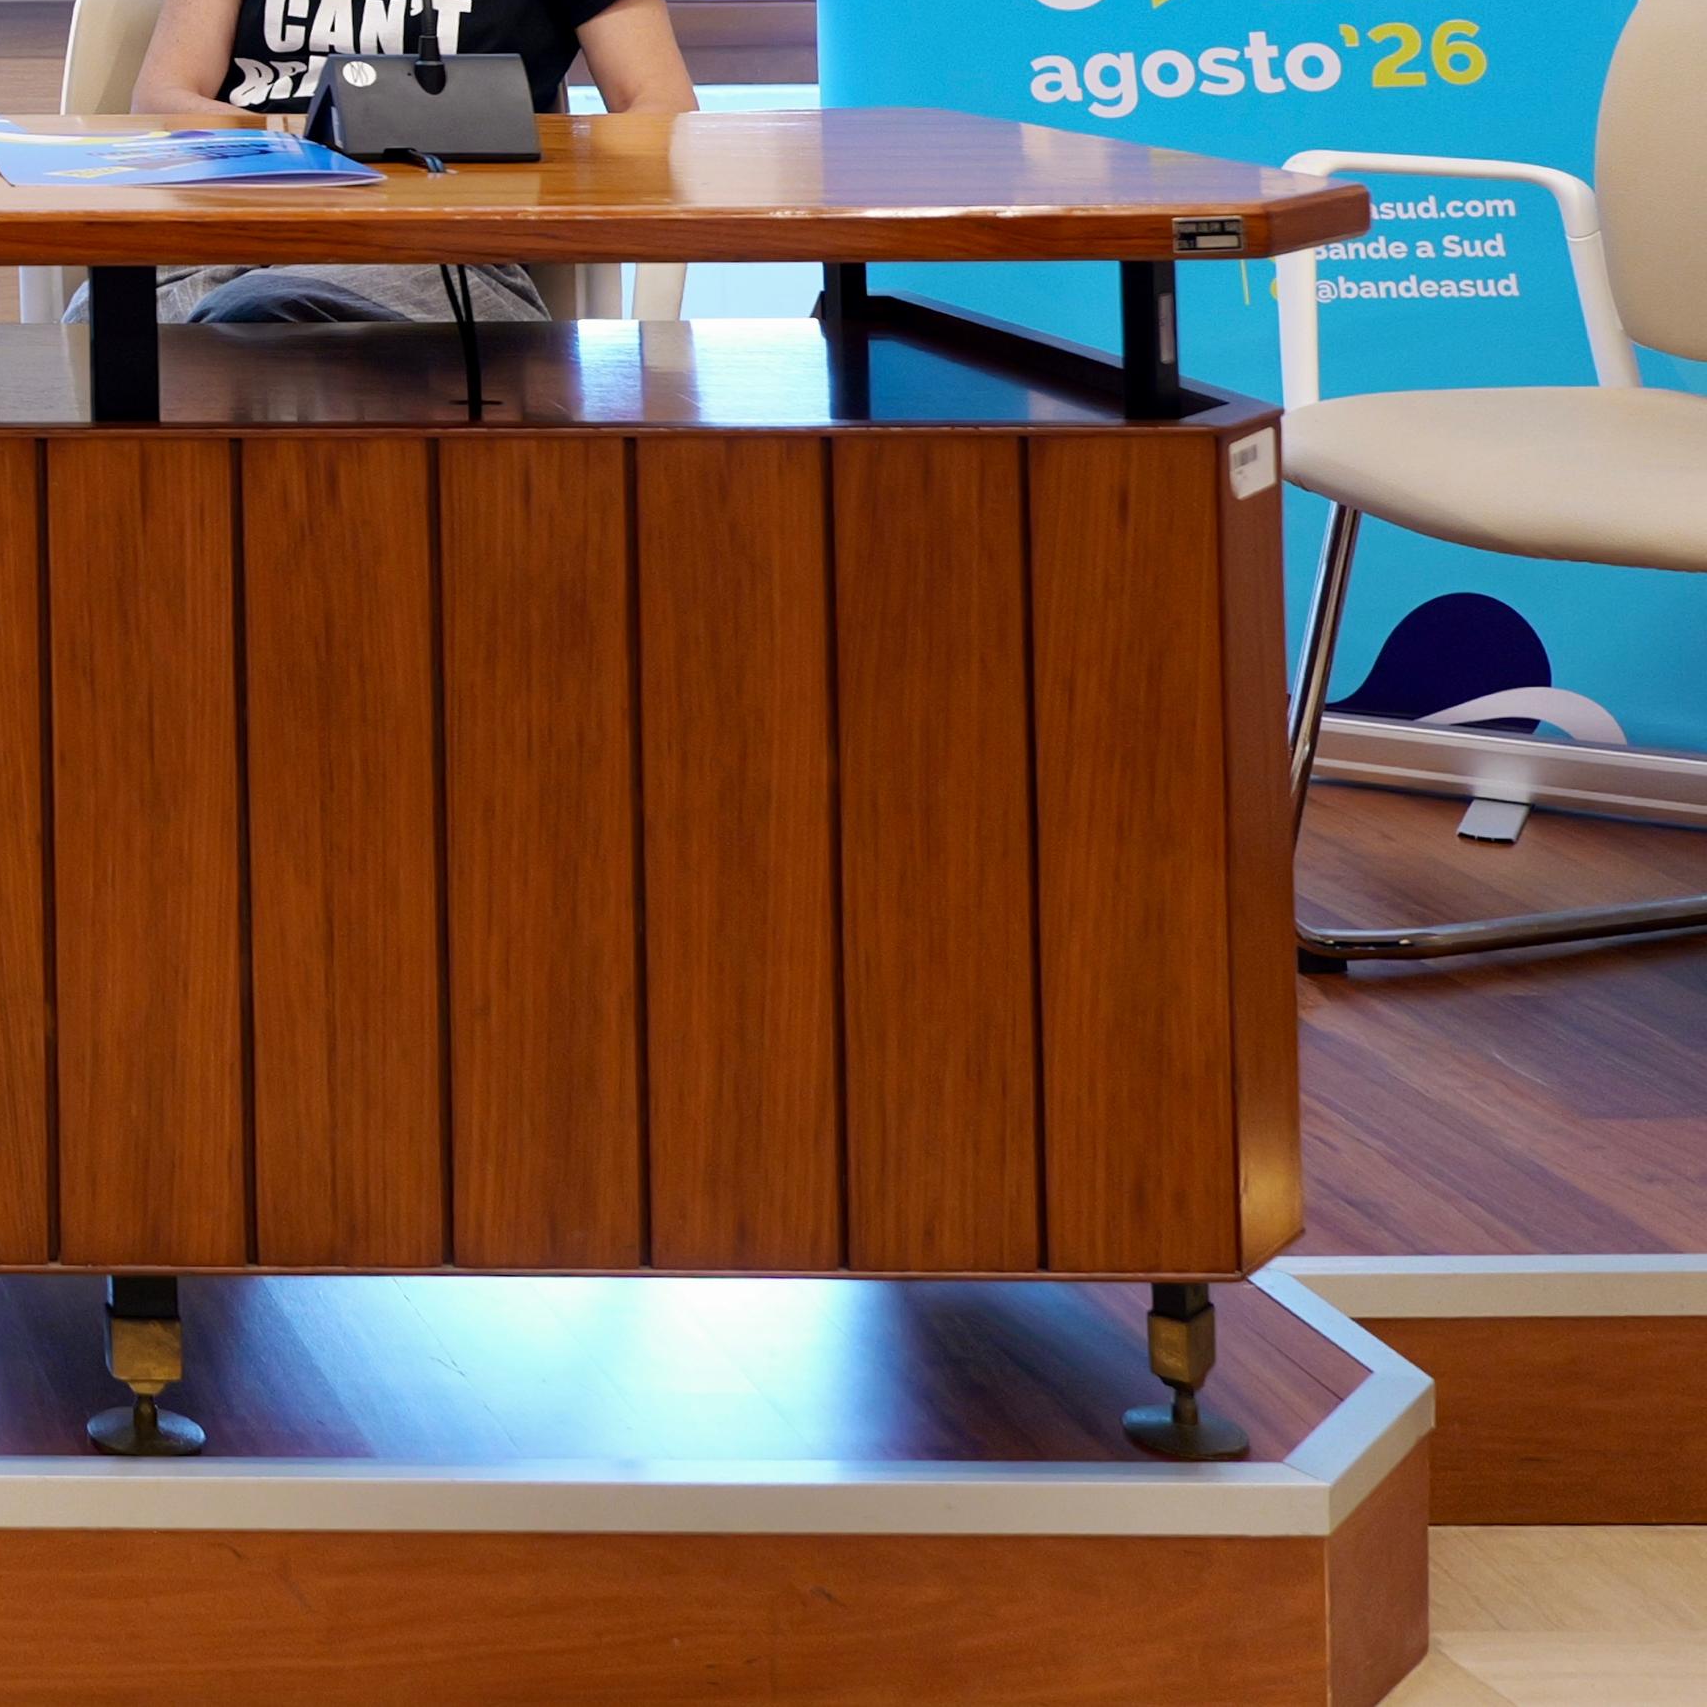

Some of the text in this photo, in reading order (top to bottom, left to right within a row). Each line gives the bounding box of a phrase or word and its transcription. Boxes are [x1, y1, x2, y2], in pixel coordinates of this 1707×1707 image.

[1415, 241, 1436, 259] a
[1442, 232, 1506, 258] Sud
[1315, 273, 1520, 303] @bandeasud
